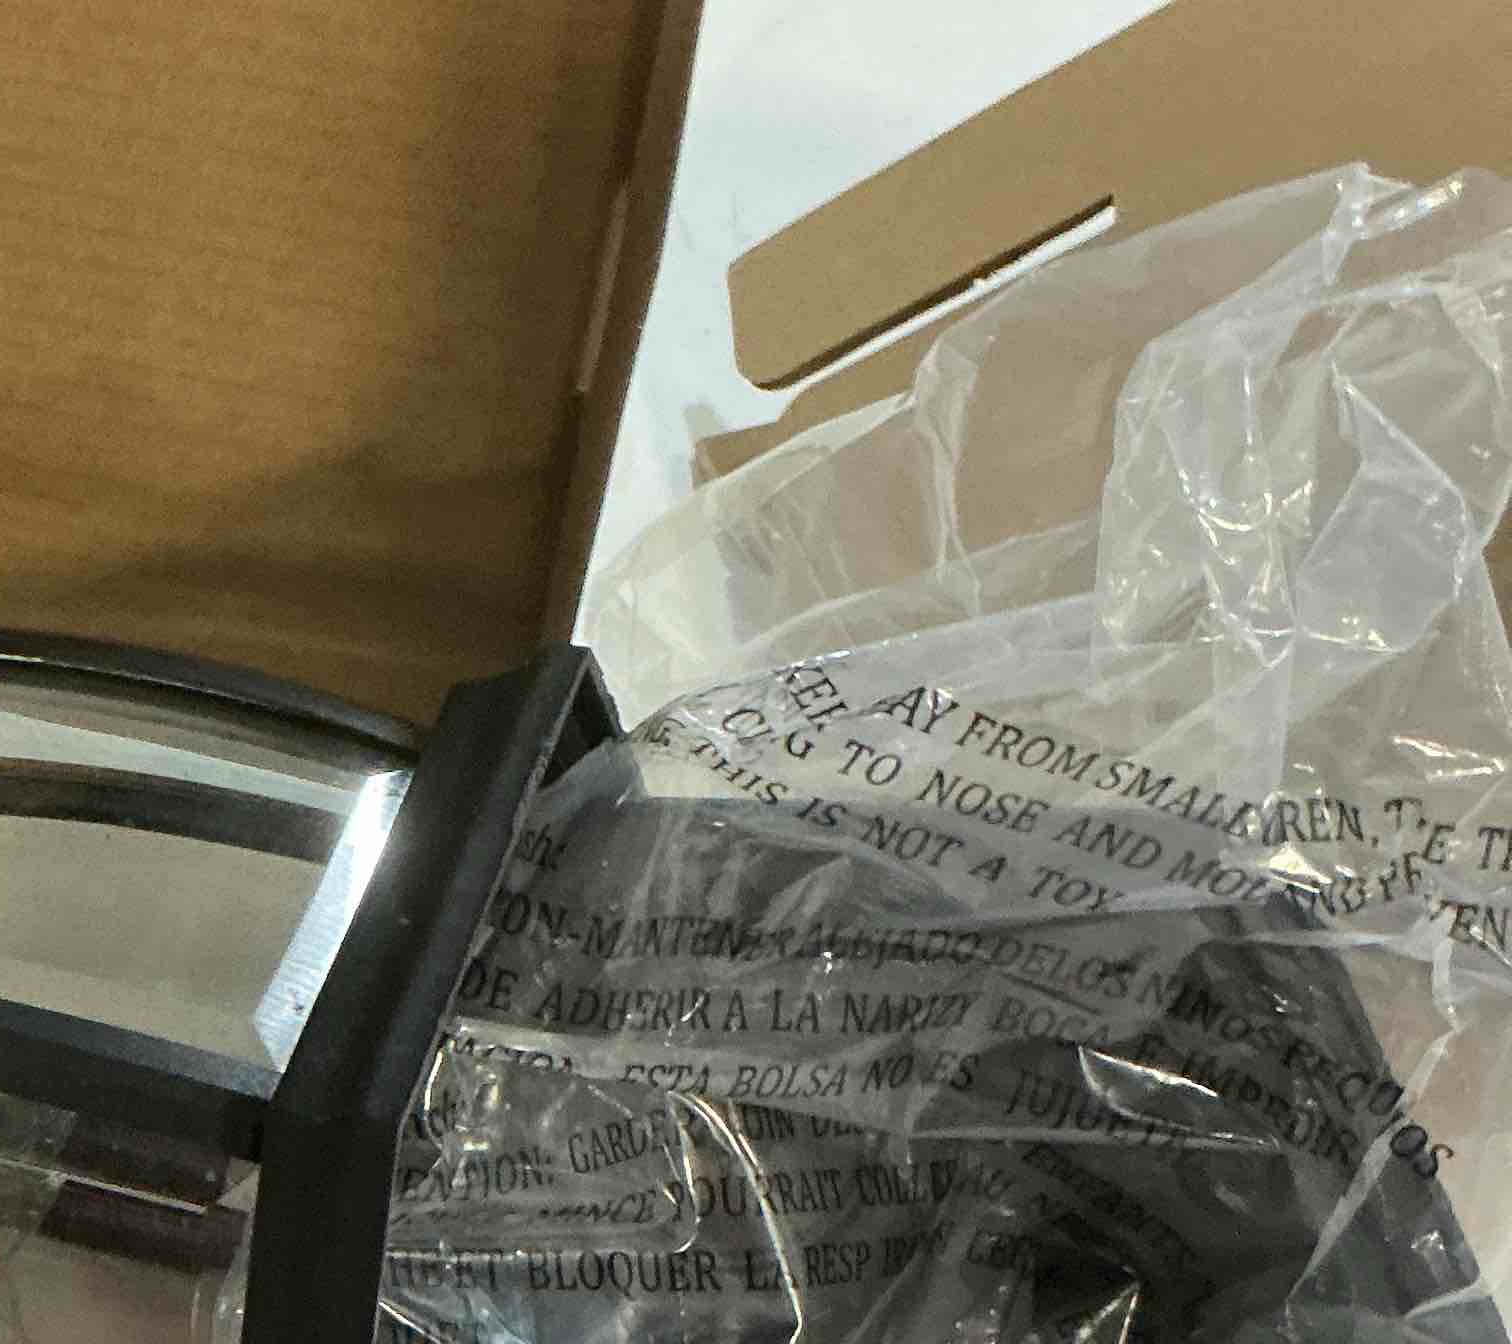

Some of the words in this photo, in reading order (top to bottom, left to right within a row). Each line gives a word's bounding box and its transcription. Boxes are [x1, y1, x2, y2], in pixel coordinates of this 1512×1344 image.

[955, 710, 1101, 784] FROM
[836, 738, 903, 788] TO
[916, 766, 1051, 836] NOSE
[1052, 810, 1164, 871] AND
[794, 796, 848, 830] IS
[859, 813, 965, 869] NOT
[968, 855, 1008, 885] A
[725, 989, 750, 1034] A
[773, 988, 820, 1034] LA
[731, 1062, 847, 1100] BOLSA
[862, 1054, 916, 1094] NO
[526, 1249, 722, 1296] BLOQUER
